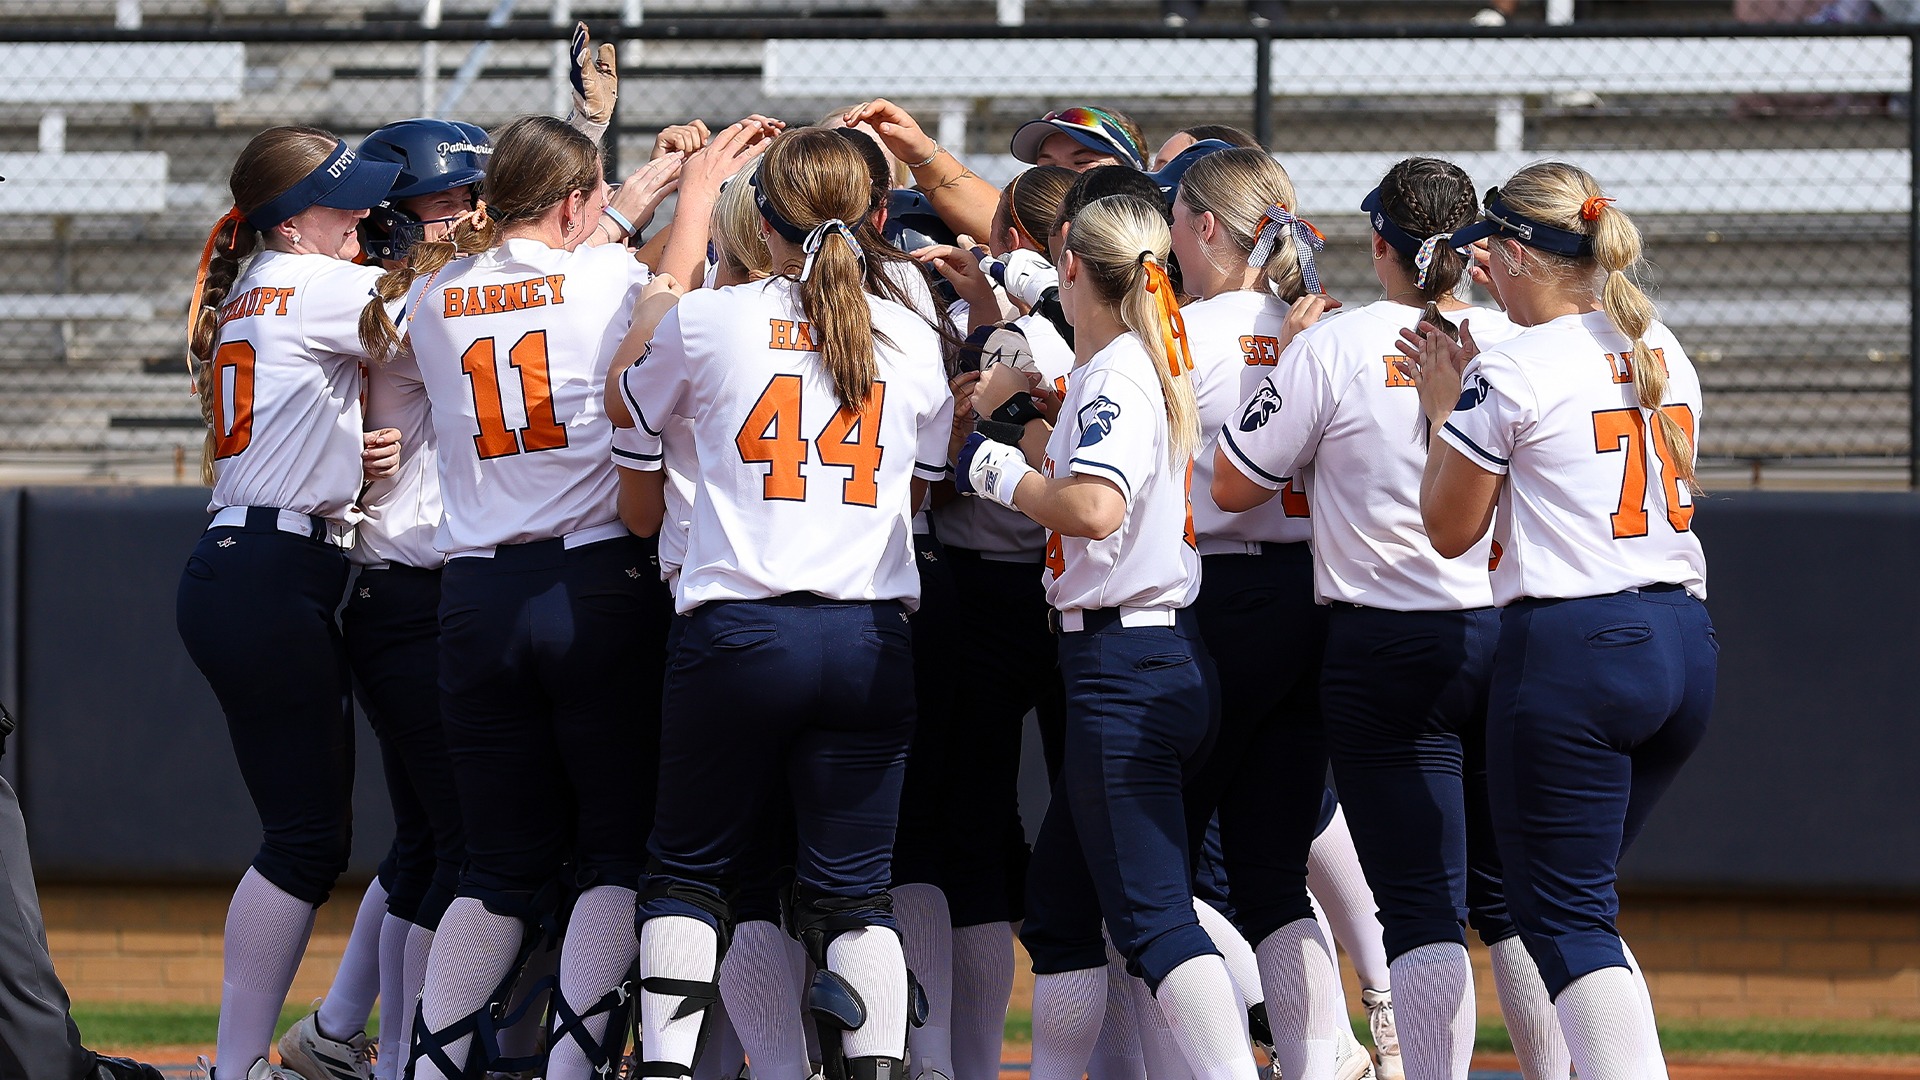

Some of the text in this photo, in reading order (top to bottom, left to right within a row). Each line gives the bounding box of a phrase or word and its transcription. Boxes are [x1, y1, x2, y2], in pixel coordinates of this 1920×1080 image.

[443, 273, 566, 318] BARNEY
[768, 318, 823, 352] HA
[212, 339, 257, 461] 0
[461, 329, 570, 461] 11
[1382, 355, 1417, 387] K
[734, 373, 887, 509] 44
[1591, 402, 1695, 540] 78
